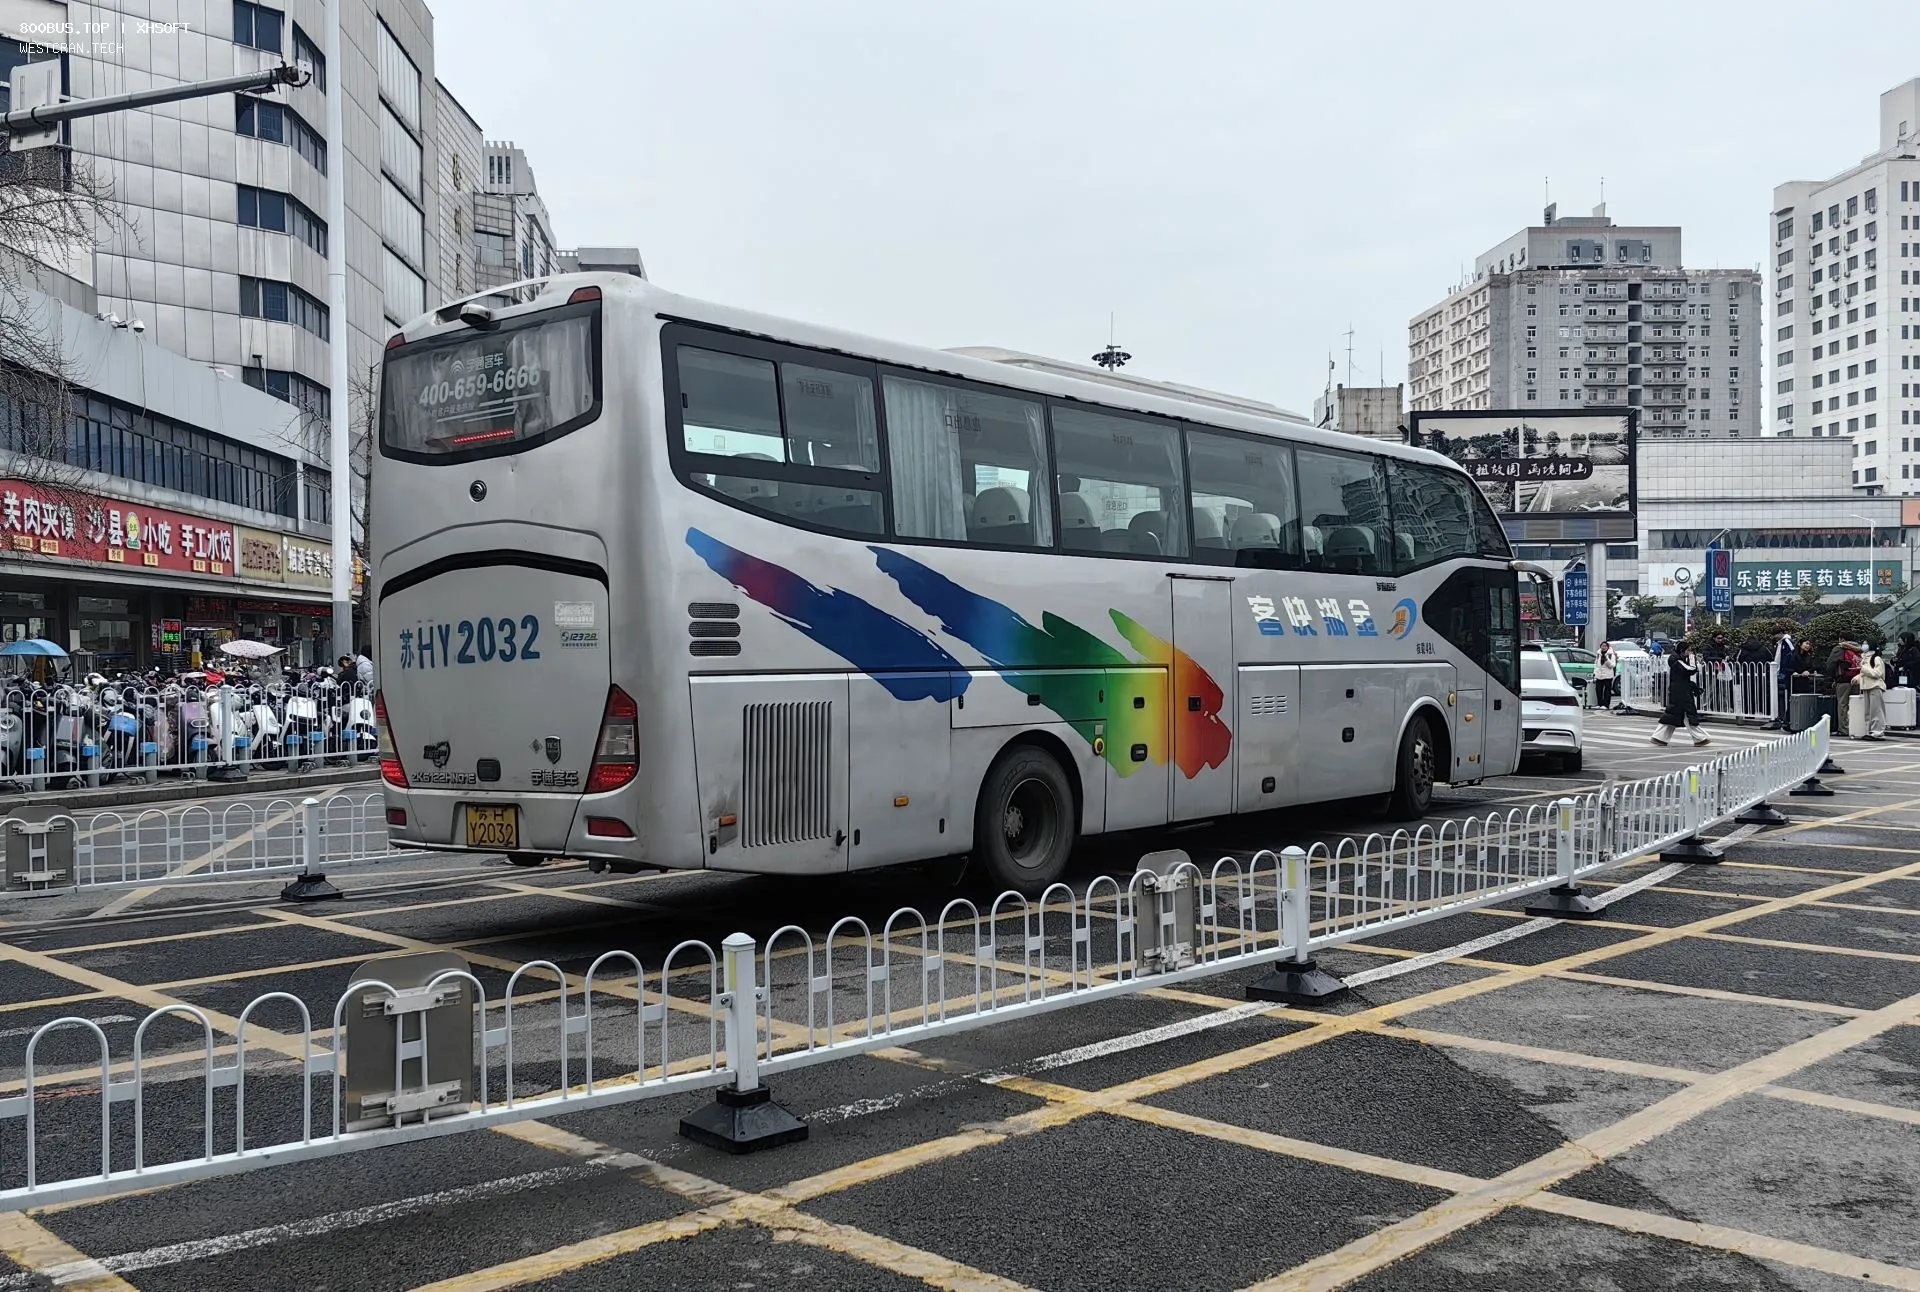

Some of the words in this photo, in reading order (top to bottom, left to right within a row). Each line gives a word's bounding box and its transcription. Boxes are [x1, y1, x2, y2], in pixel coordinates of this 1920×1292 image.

[419, 364, 541, 406] 400-659-6666
[143, 517, 172, 554] 小吃
[181, 524, 232, 563] 手工水饺
[1737, 569, 1871, 588] 乐诺佳医药连锁
[400, 614, 540, 669] 苏HY2032
[531, 769, 579, 787] 宇通客车
[470, 822, 514, 844] Y2032
